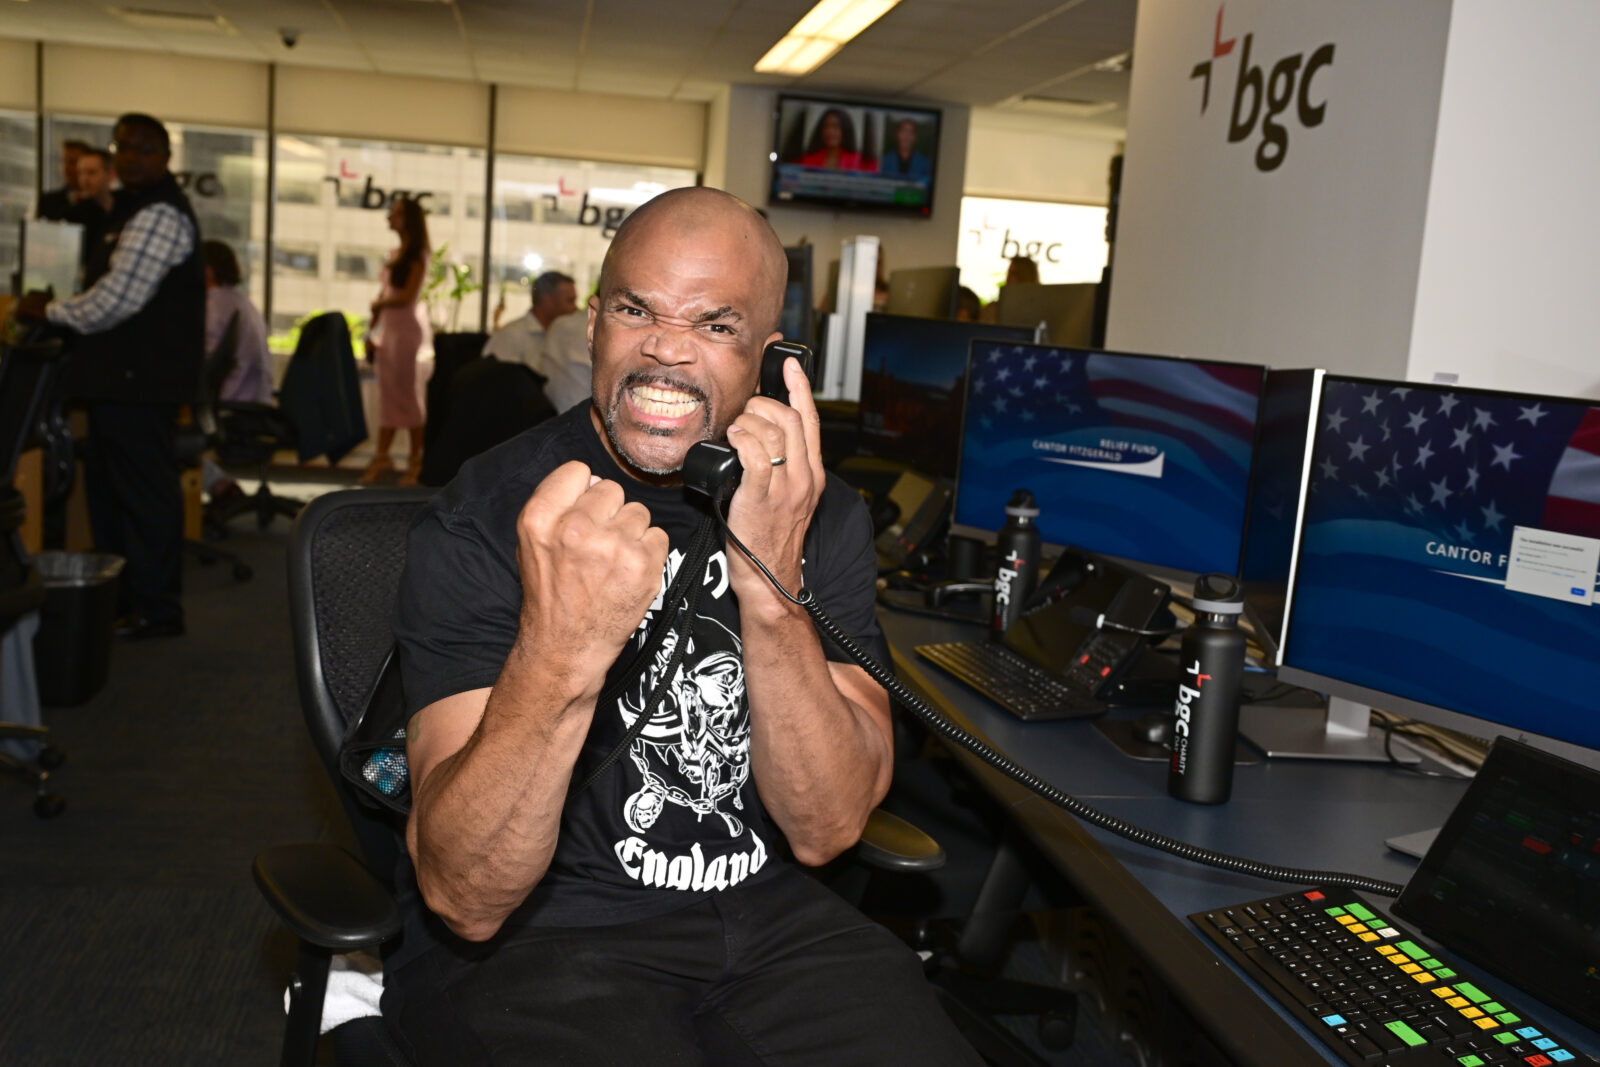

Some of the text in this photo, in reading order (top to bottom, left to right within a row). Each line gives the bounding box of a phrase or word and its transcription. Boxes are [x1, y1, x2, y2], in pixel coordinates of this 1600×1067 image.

[1227, 33, 1336, 173] bgc
[1032, 440, 1122, 461] CANTOR FITZGERALD
[1100, 438, 1158, 456] RELIEF FUND
[1425, 541, 1493, 565] CANTOR
[994, 566, 1018, 606] bgc
[1174, 684, 1201, 738] bgc
[1178, 738, 1189, 775] CHARITY
[614, 827, 768, 892] England
